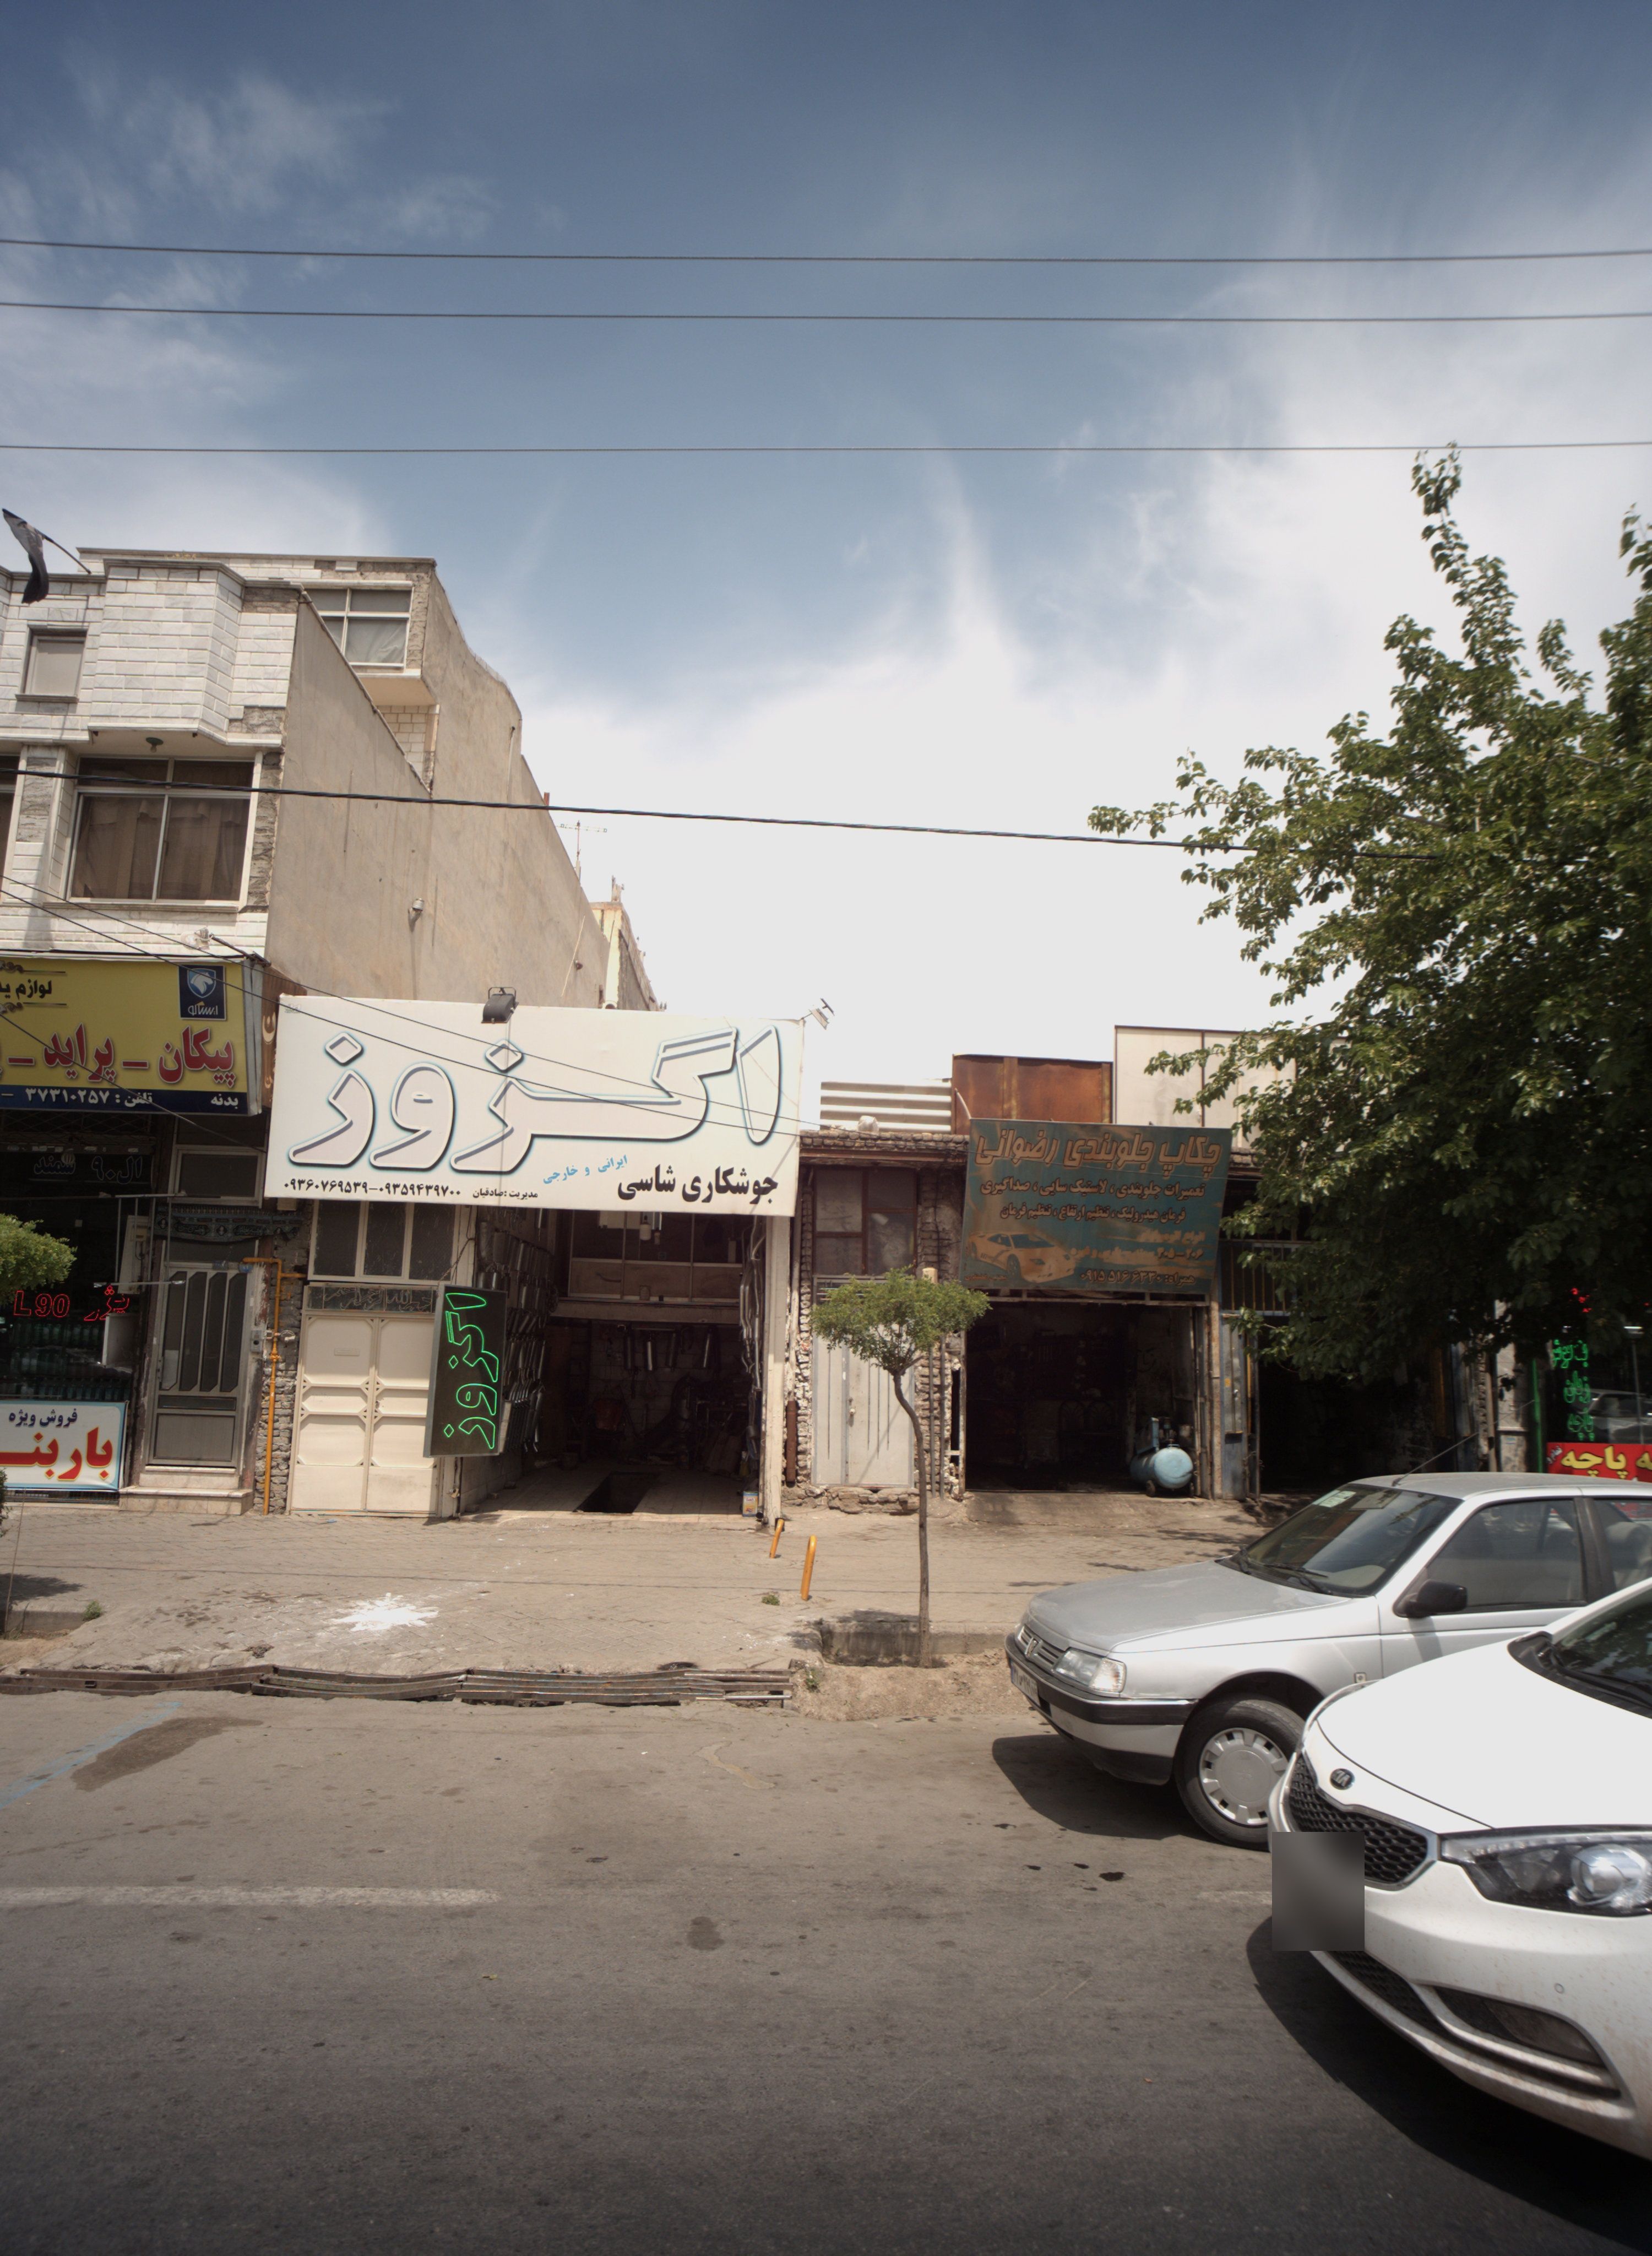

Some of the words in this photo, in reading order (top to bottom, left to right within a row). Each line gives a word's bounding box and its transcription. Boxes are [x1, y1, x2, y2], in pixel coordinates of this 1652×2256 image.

[15, 979, 52, 999] لوازم
[44, 1023, 116, 1082] پراید
[159, 1026, 236, 1087] پیکان
[25, 1087, 110, 1104] ۳۷۳۱۰۲۵۷
[210, 1094, 239, 1109] بدنه
[289, 1024, 782, 1174] اگزوز
[976, 1129, 1059, 1167] رضوانی
[1064, 1132, 1154, 1171] جلوبندی
[584, 1166, 590, 1176] و
[598, 1154, 628, 1174] ایرانی
[542, 1166, 578, 1185] خارجی
[617, 1164, 676, 1201] شاسی
[682, 1166, 779, 1205] جوشکاری
[981, 1175, 1030, 1195] صداگیری
[1069, 1178, 1108, 1196] لاستیک
[1164, 1182, 1205, 1200] تعمیرات
[1000, 1202, 1026, 1219] فرمان
[1028, 1202, 1051, 1219] تنظیم
[1086, 1204, 1110, 1221] تنظیم
[1160, 1207, 1186, 1224] فرمان
[443, 1292, 499, 1450] اگزوز
[9, 1409, 36, 1427] ویژه
[40, 1408, 78, 1428] فروش
[1561, 1445, 1629, 1479] پاچه
